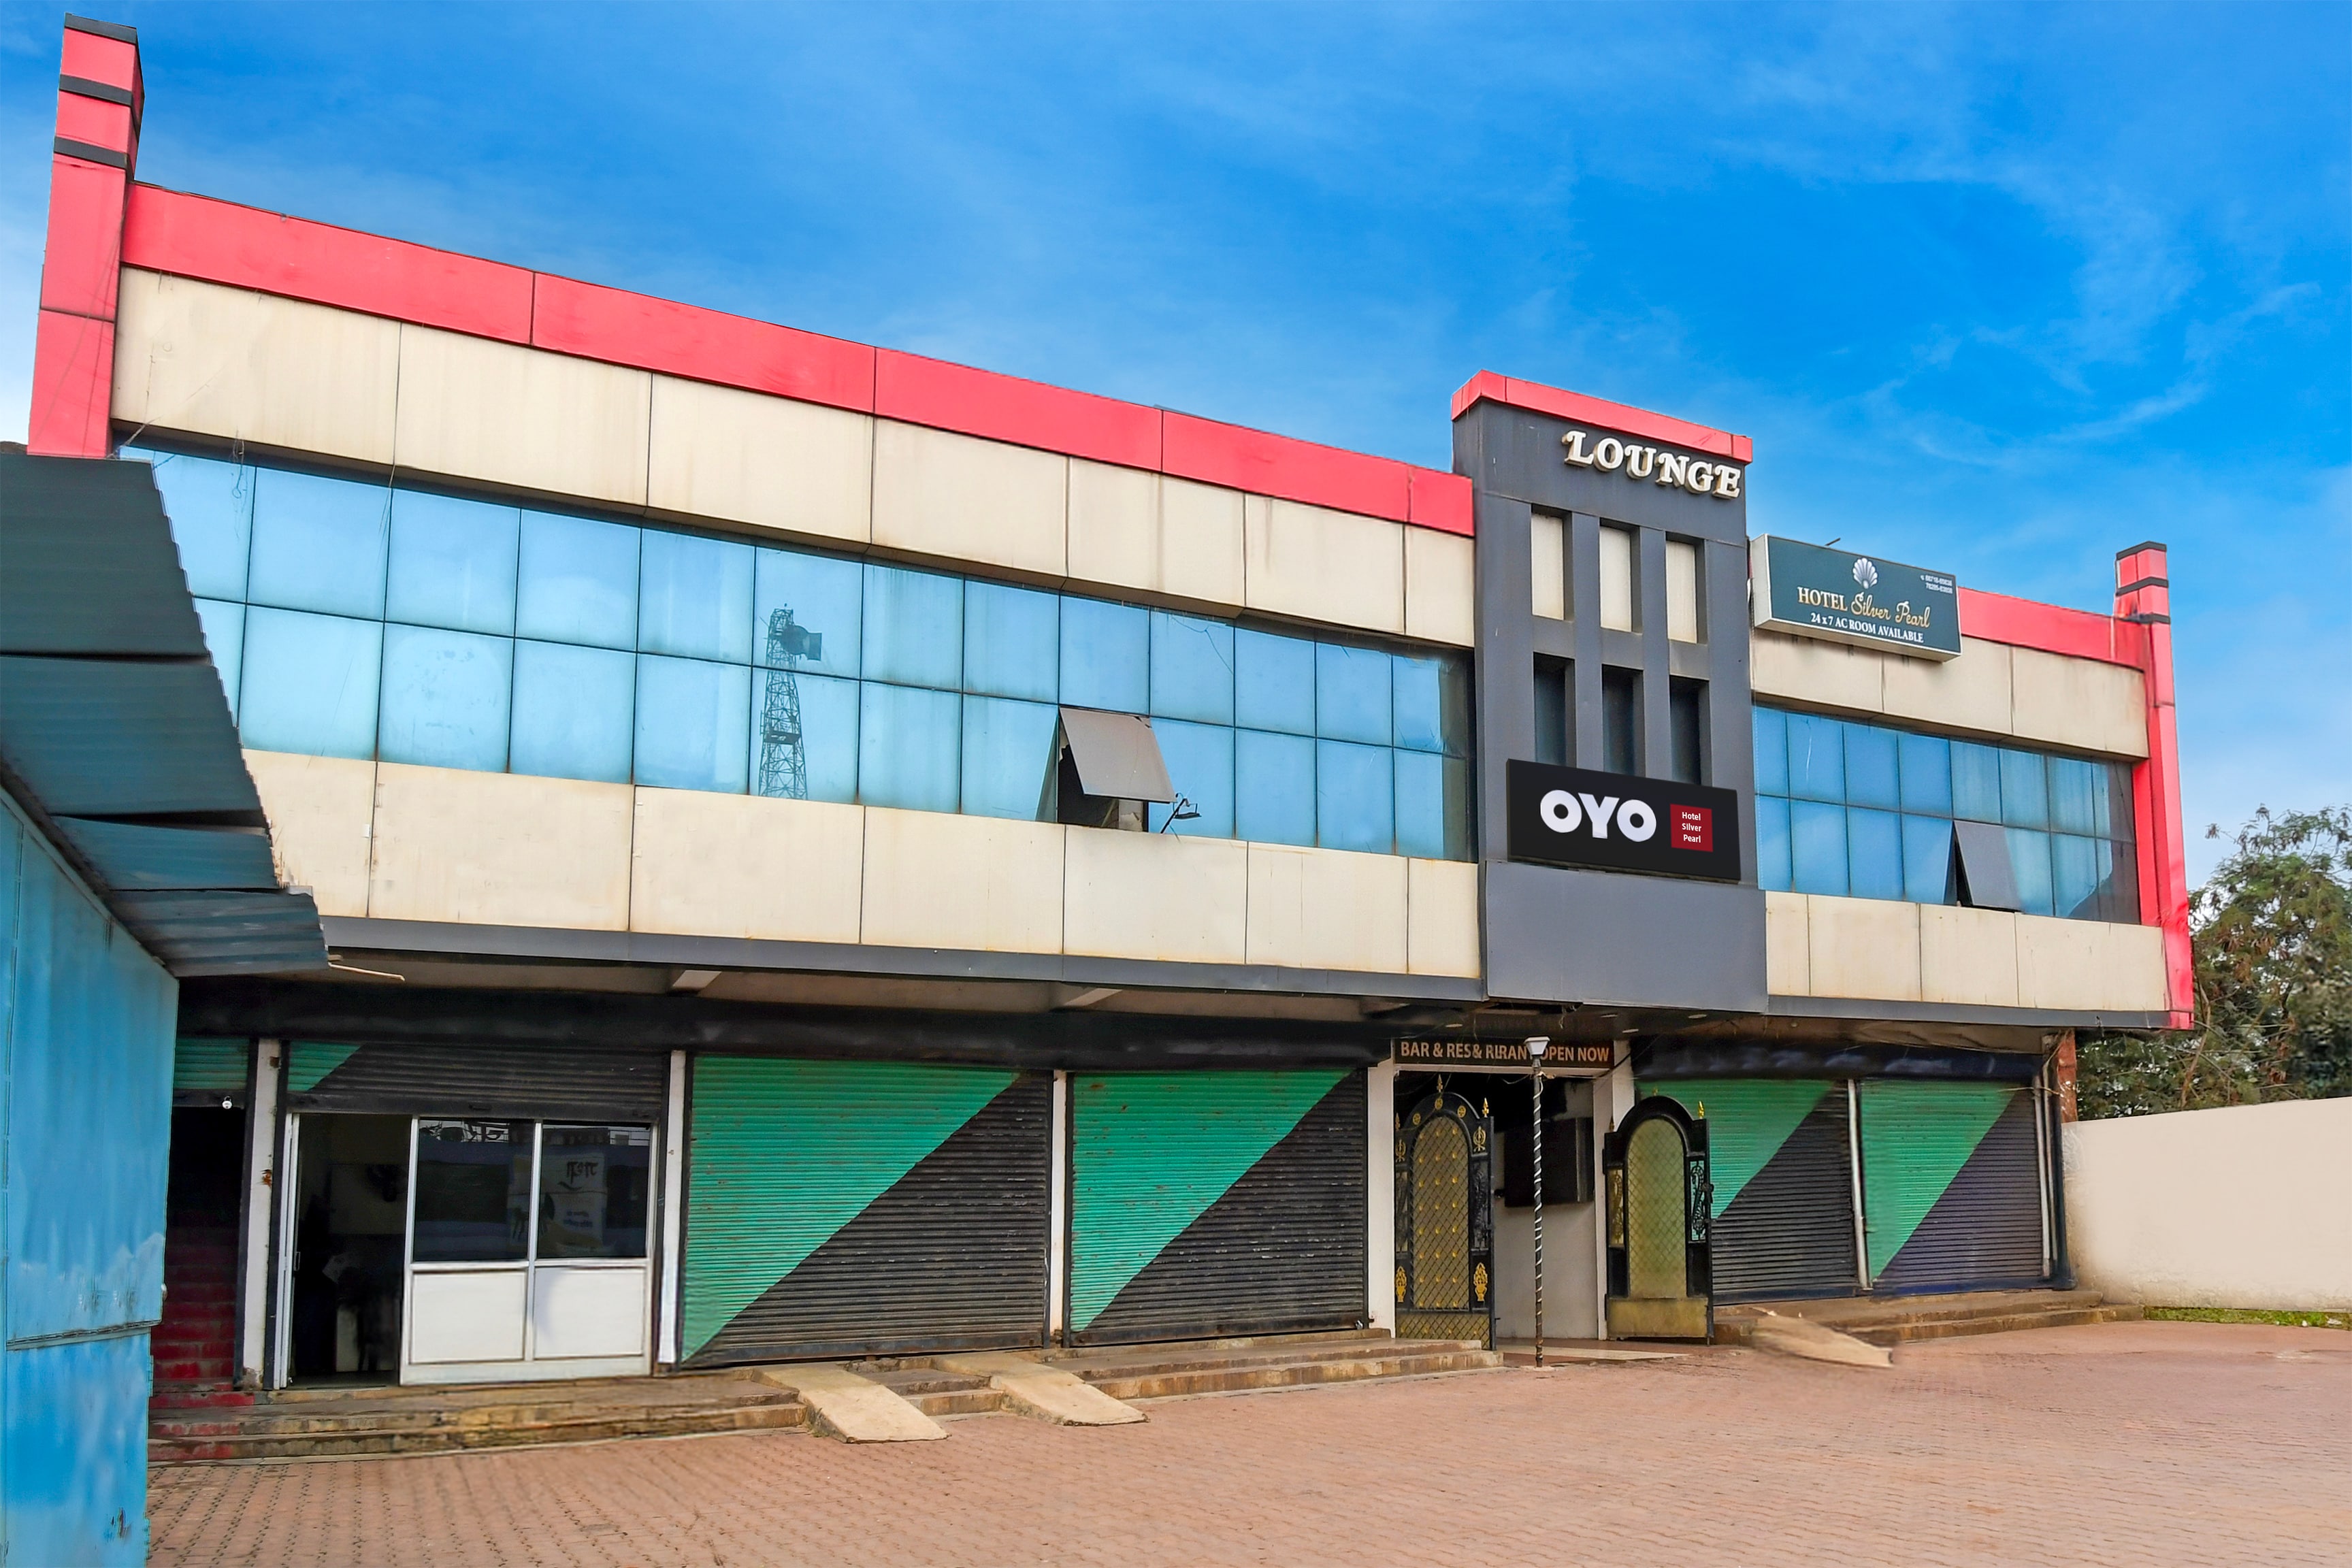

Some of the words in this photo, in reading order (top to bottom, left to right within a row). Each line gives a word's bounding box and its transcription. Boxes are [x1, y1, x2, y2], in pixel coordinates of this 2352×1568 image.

[1563, 430, 1741, 499] LOUNGE
[1797, 587, 1848, 612] HOTEL
[1850, 591, 1891, 621] Silver
[1895, 600, 1930, 628] Pearl
[1835, 617, 1848, 628] AC
[1849, 620, 1876, 634] ROOM
[1878, 626, 1925, 643] AVAILABLE
[1540, 789, 1657, 843] OYO
[1682, 811, 1701, 821] Hotel
[1683, 834, 1701, 843] Pearl
[1401, 1041, 1430, 1057] BAR
[1433, 1042, 1443, 1058] &
[1578, 1047, 1609, 1062] NOW
